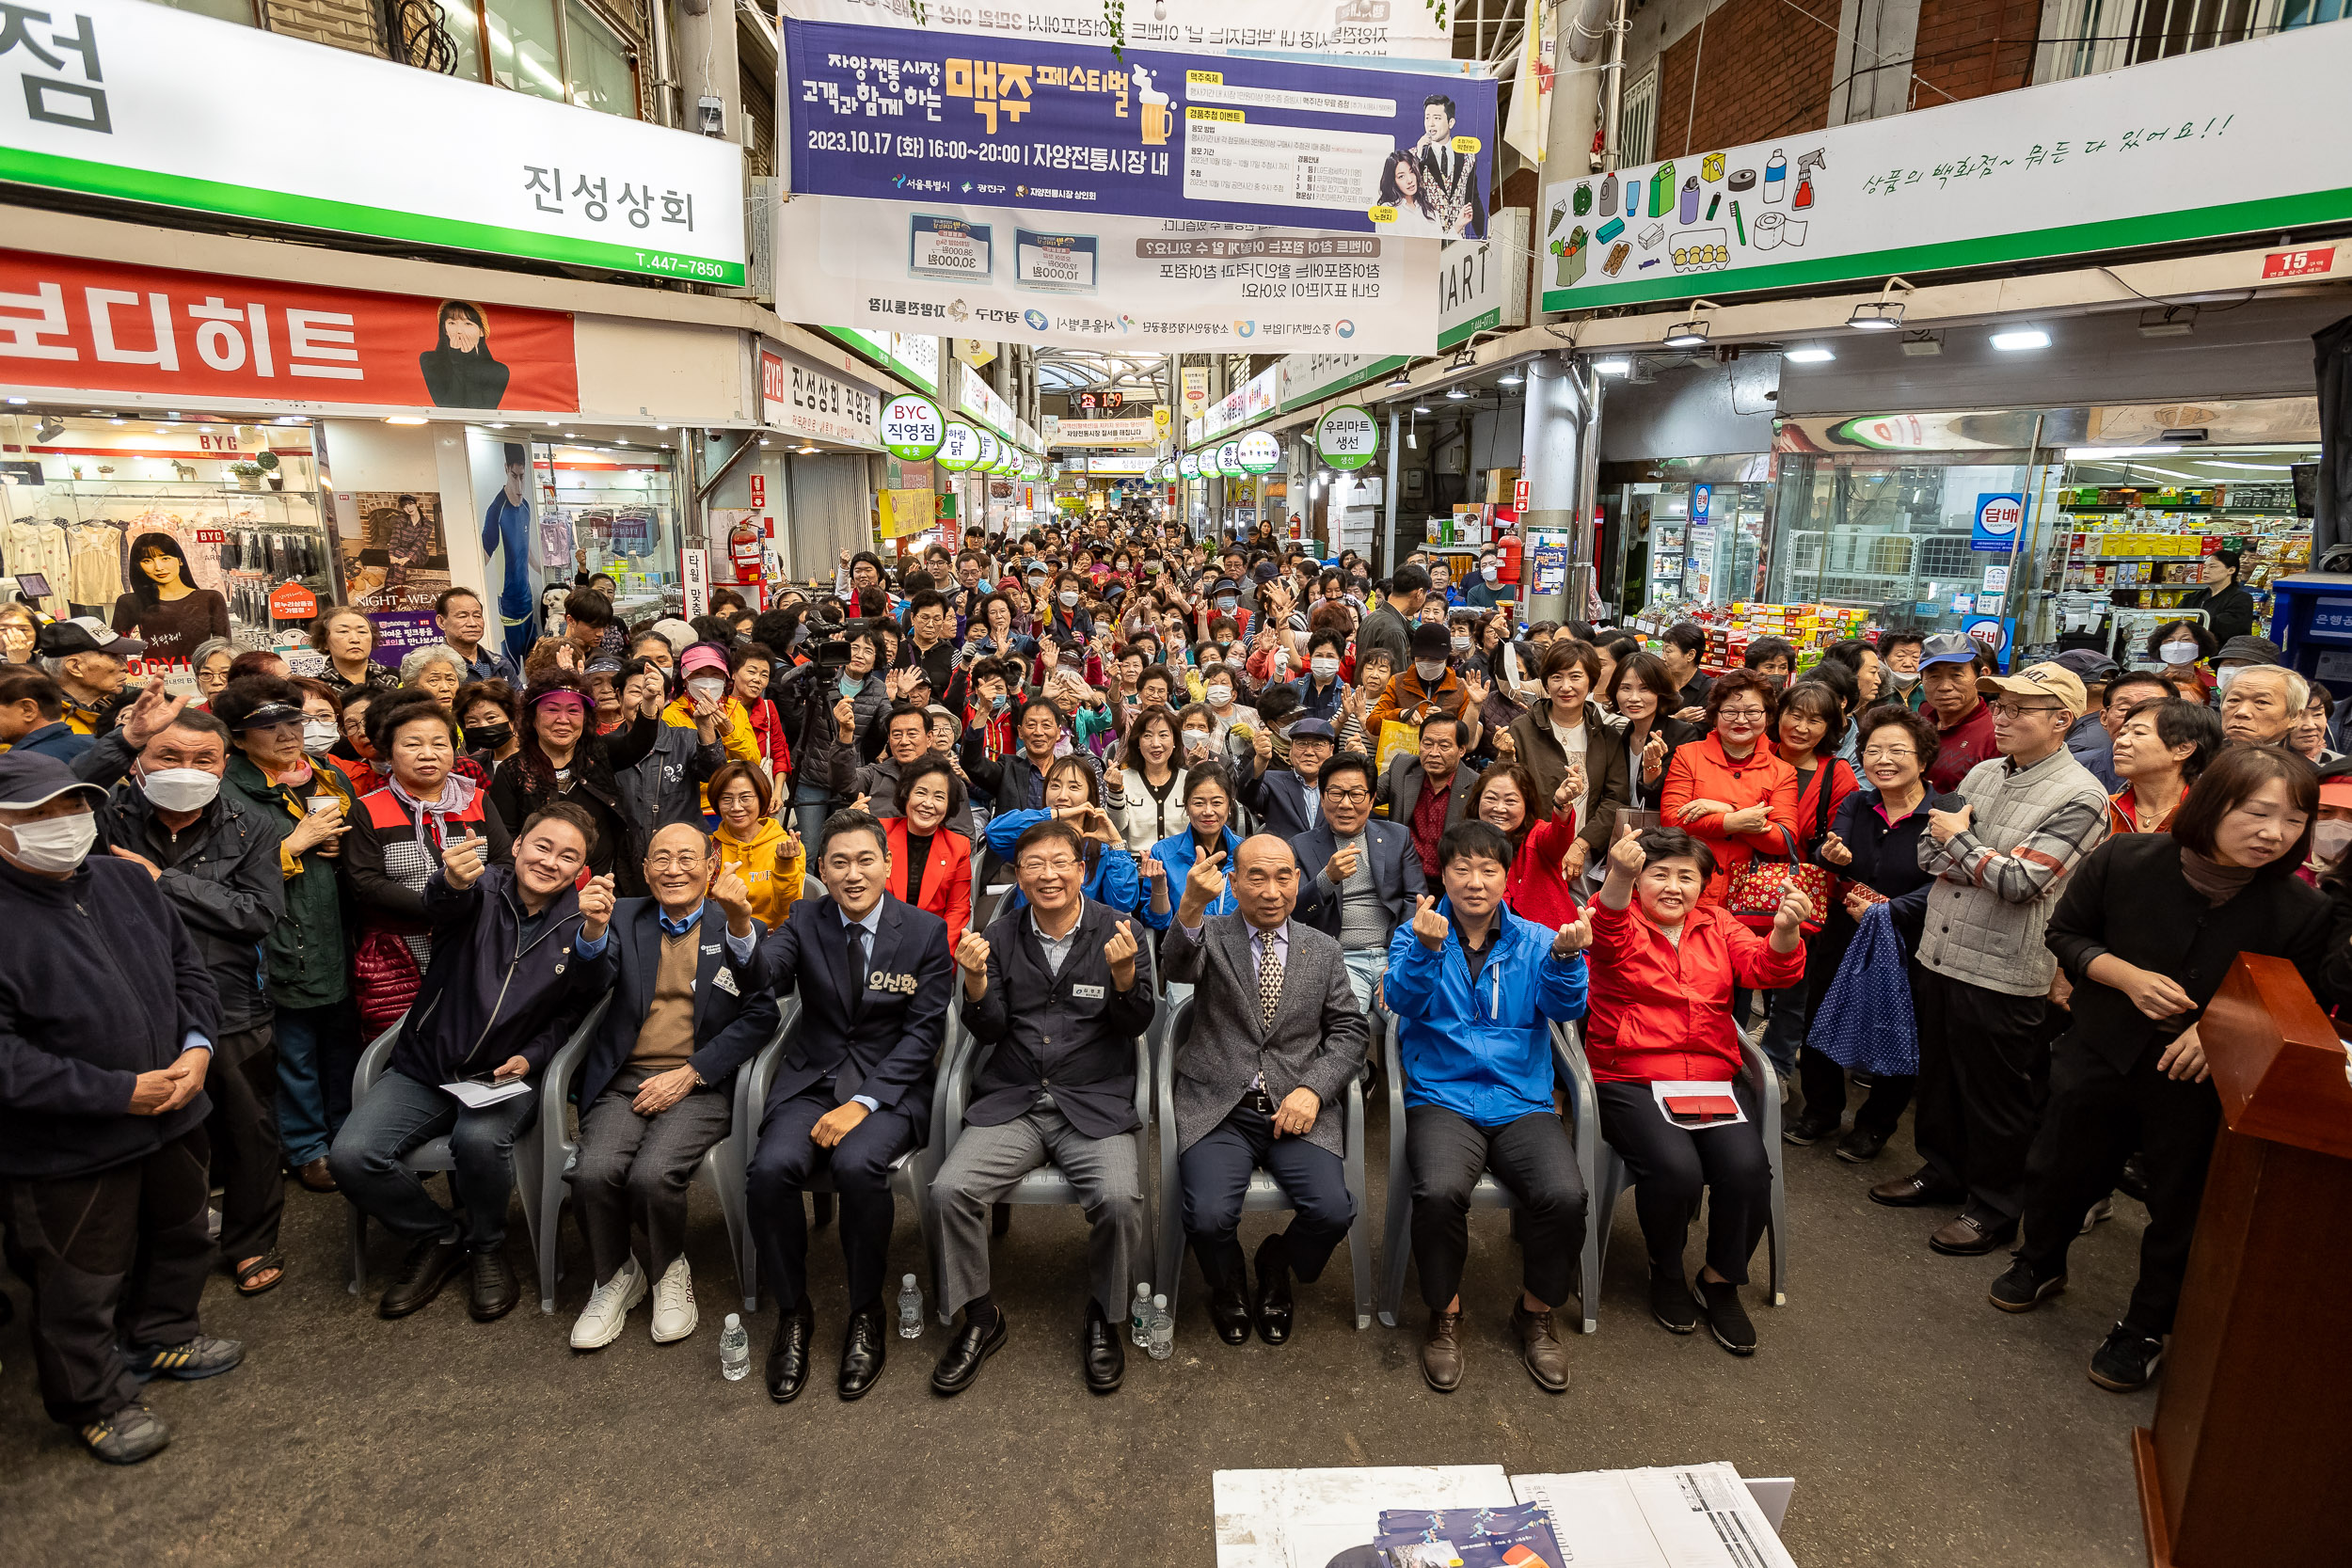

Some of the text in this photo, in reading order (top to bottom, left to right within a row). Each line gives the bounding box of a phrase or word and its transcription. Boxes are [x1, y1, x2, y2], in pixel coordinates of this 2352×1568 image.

[0, 5, 113, 135] 점
[1190, 71, 1219, 84] 맥주축제
[803, 80, 942, 122] 고객과 함께 하는
[945, 57, 1129, 135] 맥주 페스티벌
[1190, 109, 1241, 122] 경품추첨 이벤트
[808, 130, 1169, 176] 2023.10.17 (화) 16:00~20:00 자양전통시장 내
[1203, 148, 1215, 156] 기간
[1863, 168, 1923, 197] 상품의
[2025, 141, 2070, 170] 뭐든
[2085, 139, 2106, 154] 다
[2119, 114, 2234, 152] 있어요!!
[1190, 169, 1201, 178] 추첨
[906, 178, 950, 192] 서울특별시
[977, 183, 1007, 195] 광진구
[523, 165, 694, 232] 진성상회
[635, 252, 724, 279] T.447-7850
[2281, 251, 2308, 271] 15
[0, 281, 364, 381] 보디히트
[764, 359, 783, 399] BYC
[792, 366, 872, 426] 진성상회 직영점
[1102, 392, 1122, 408] 19
[894, 404, 928, 420] BYC
[887, 423, 935, 442] 직영점
[948, 429, 966, 440] 하림
[1324, 420, 1371, 435] 우리마트
[199, 435, 238, 451] BYC
[950, 441, 964, 456] 닭
[1336, 436, 1359, 451] 생선
[902, 447, 921, 456] 속옷
[1340, 456, 1355, 465] 생선
[1985, 508, 2018, 524] 담배
[199, 531, 222, 542] BYC
[688, 555, 702, 616] 타월 맞춤
[356, 594, 399, 607] NIGHT
[151, 631, 183, 648] 부탁해!
[404, 627, 434, 638] 핑크퐁을
[869, 971, 918, 994] 오신환
